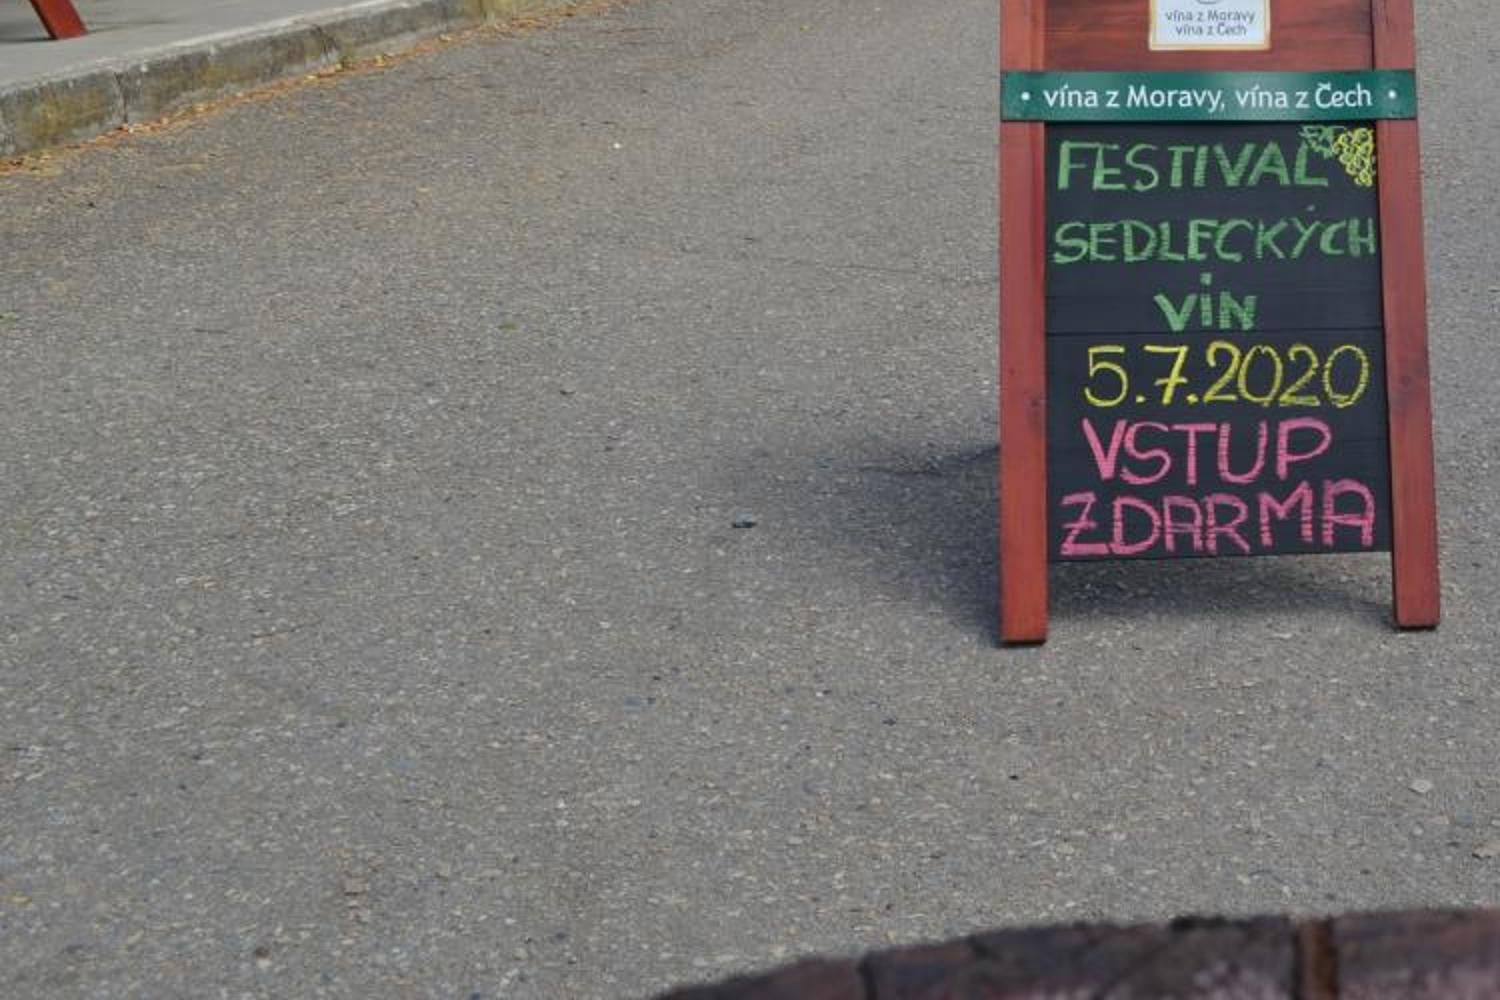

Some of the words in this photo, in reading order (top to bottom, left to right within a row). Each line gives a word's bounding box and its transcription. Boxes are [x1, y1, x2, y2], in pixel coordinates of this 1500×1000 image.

[1165, 9, 1193, 22] vína
[1196, 11, 1204, 22] z
[1207, 9, 1256, 25] Moravy
[1175, 23, 1204, 36] vína
[1043, 84, 1099, 107] vína
[1105, 91, 1120, 107] z
[1127, 85, 1226, 113] Moravy,
[1235, 84, 1288, 107] vína
[1295, 91, 1309, 107] z
[1315, 82, 1372, 108] Čech
[1057, 139, 1329, 191] FESTIVAL
[1053, 204, 1376, 263] SEDLECKÝCH
[1084, 340, 1369, 408] 5.7.2020
[1081, 416, 1333, 485] VSTUP
[1059, 478, 1376, 556] ZDARMA
